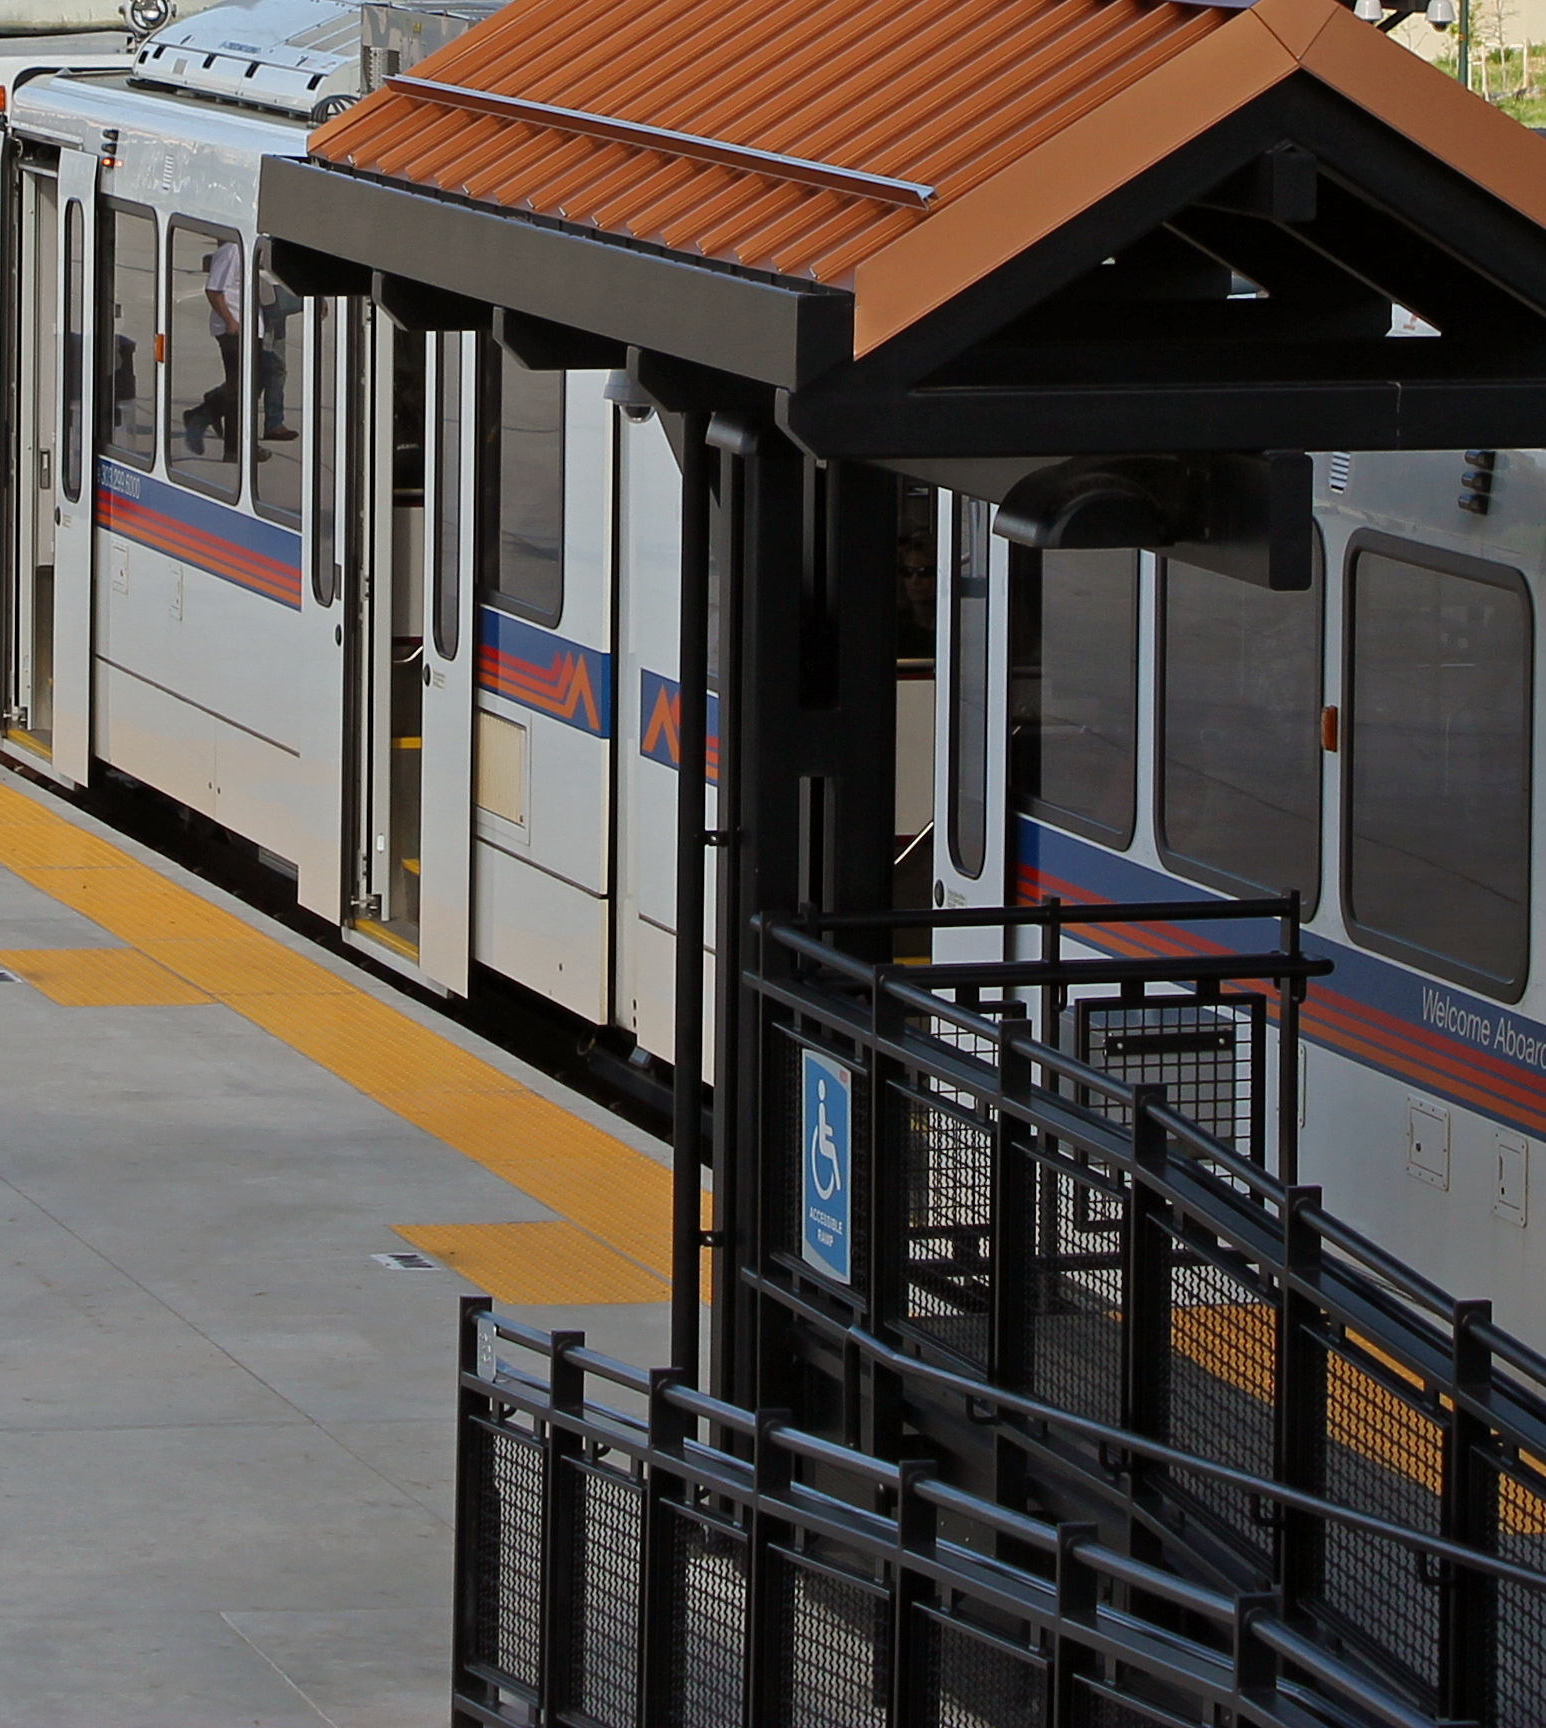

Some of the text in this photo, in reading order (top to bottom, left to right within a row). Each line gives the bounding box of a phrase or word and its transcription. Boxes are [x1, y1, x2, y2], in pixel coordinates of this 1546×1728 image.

[1422, 986, 1491, 1046] Welcome
[809, 1206, 844, 1236] ACCESSIBLE
[817, 1228, 835, 1248] RAMP
